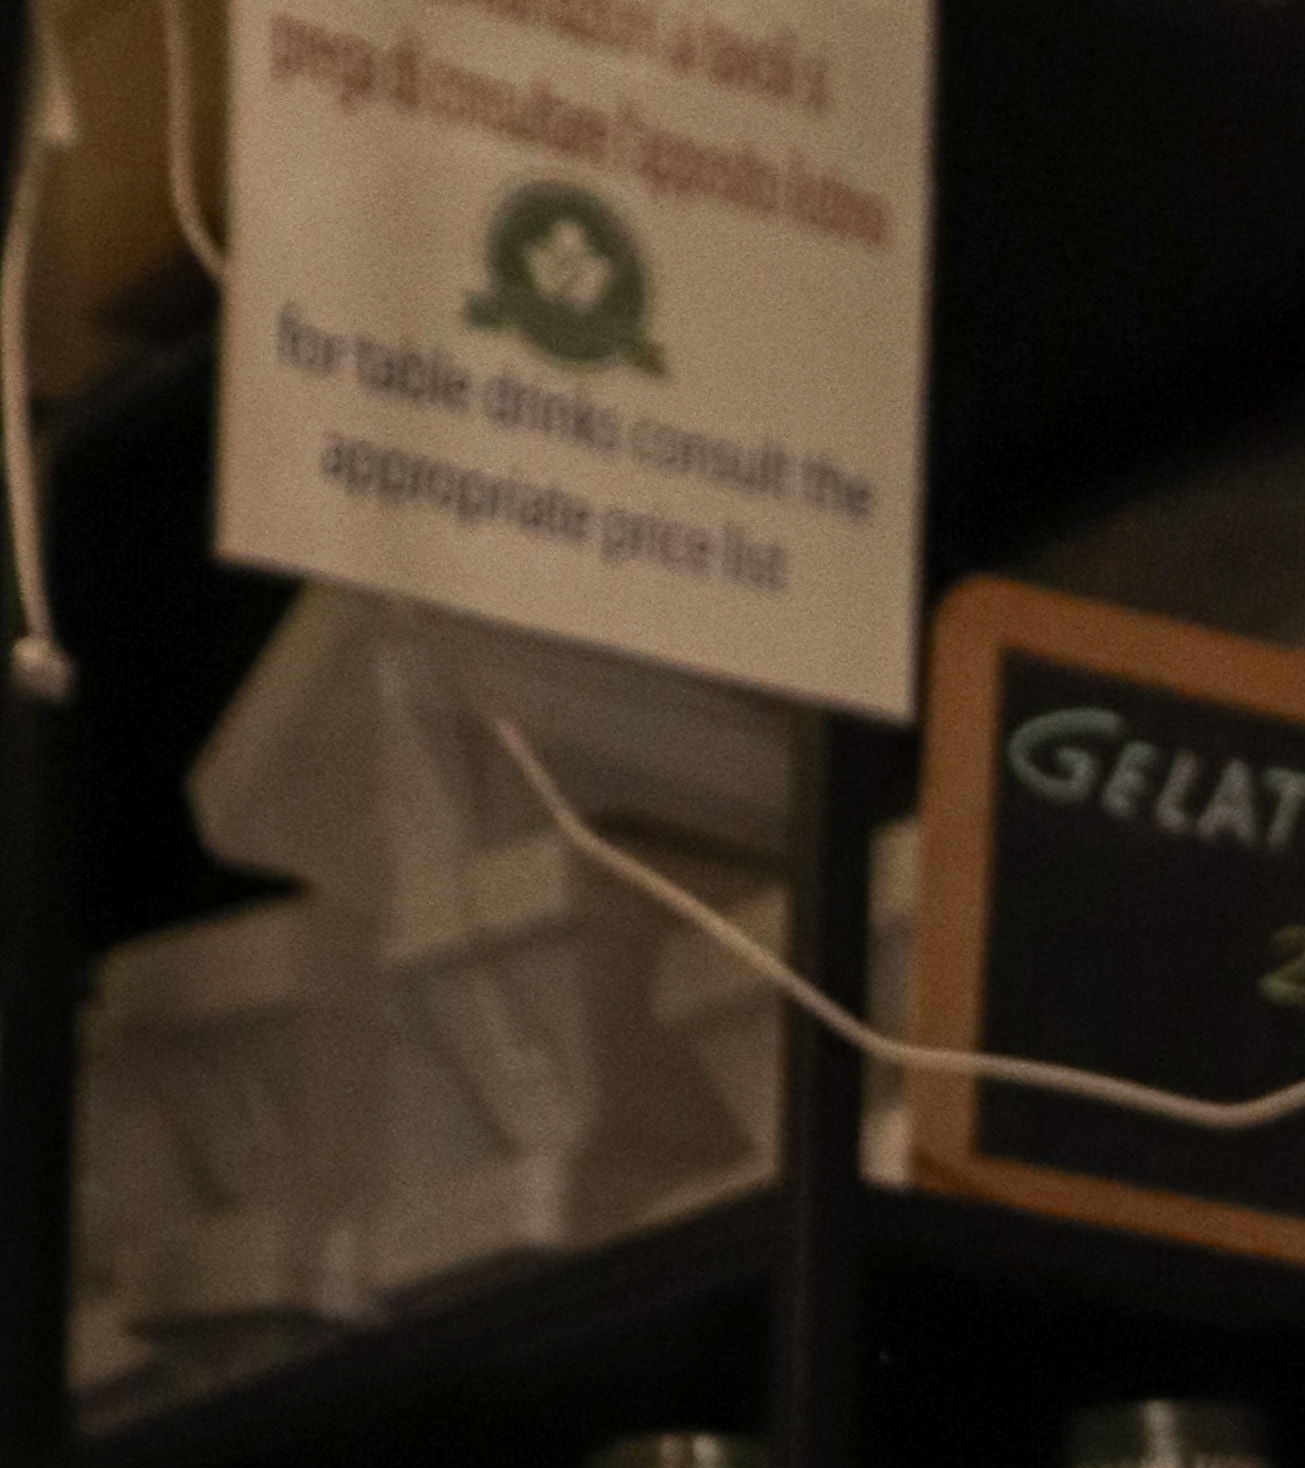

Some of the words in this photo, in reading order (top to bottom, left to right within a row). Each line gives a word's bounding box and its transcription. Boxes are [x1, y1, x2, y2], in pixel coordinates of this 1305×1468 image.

[276, 301, 345, 378] for
[355, 336, 472, 411] table
[485, 373, 620, 455] drinks
[630, 417, 787, 497] consult
[800, 453, 876, 525] the
[320, 434, 592, 545] appropriate
[600, 507, 712, 578] price
[722, 521, 787, 594] list
